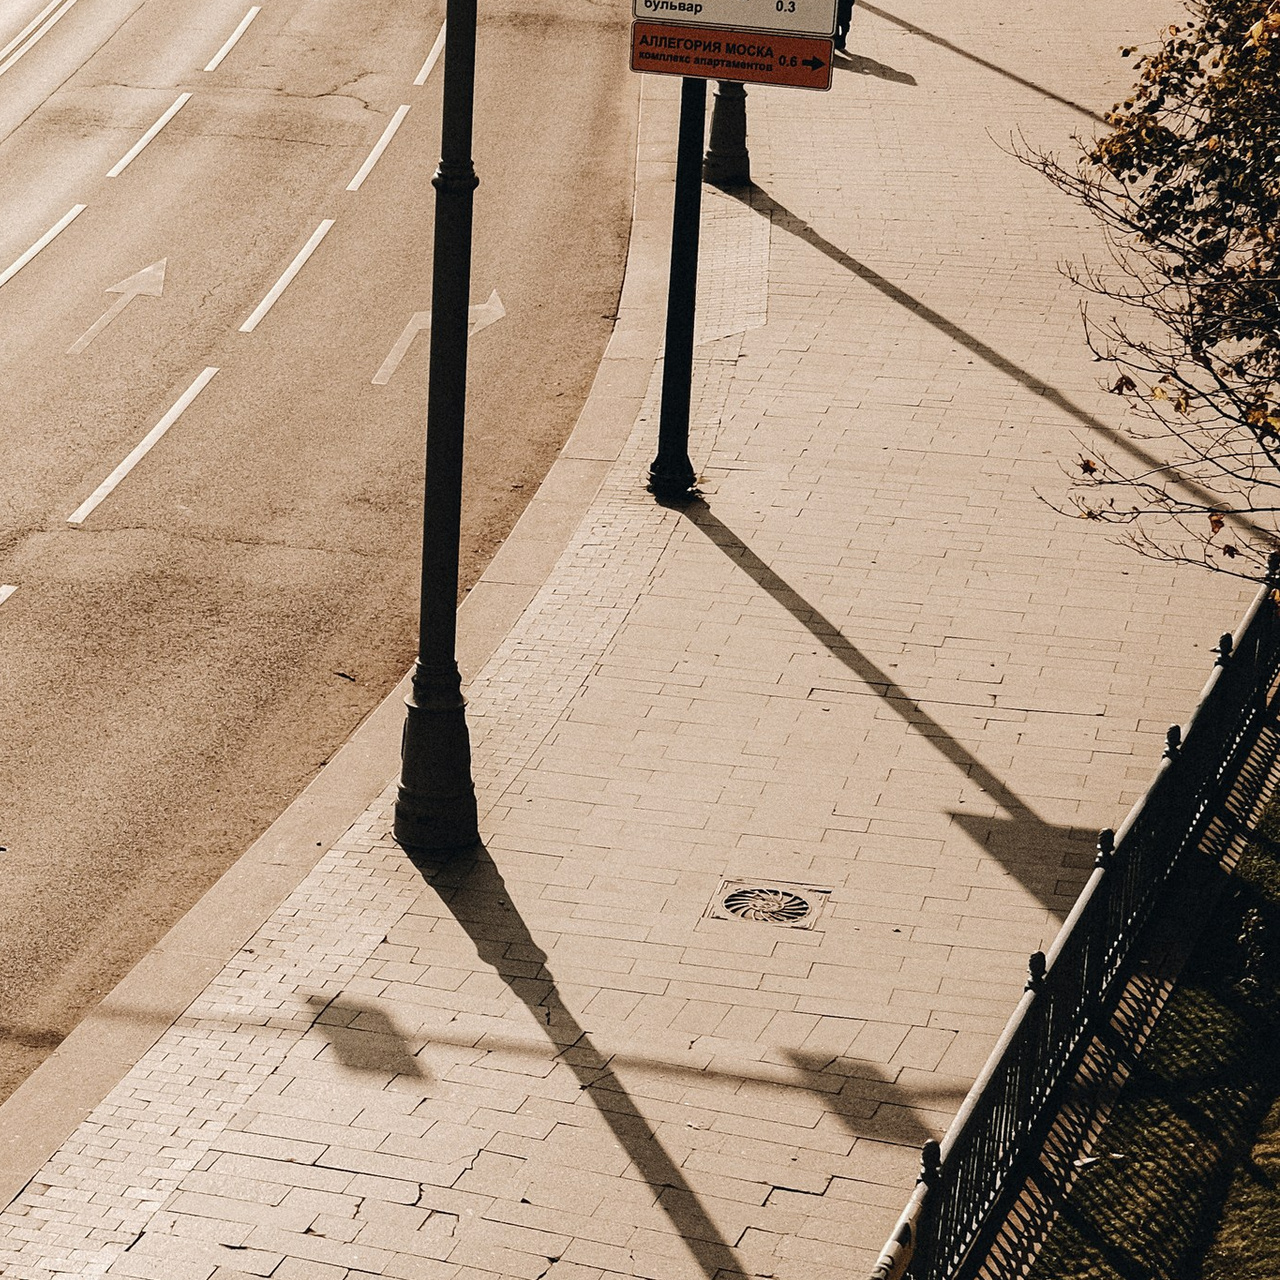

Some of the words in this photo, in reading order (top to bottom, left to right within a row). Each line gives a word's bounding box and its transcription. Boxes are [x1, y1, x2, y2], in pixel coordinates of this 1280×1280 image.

[775, 0, 796, 13] 0.3
[639, 34, 721, 53] АЛЛЕГОРИЯ
[725, 42, 774, 58] МОСКА
[638, 51, 691, 64] комплекс
[693, 55, 773, 72] апартаментов
[778, 55, 798, 68] 0.6
